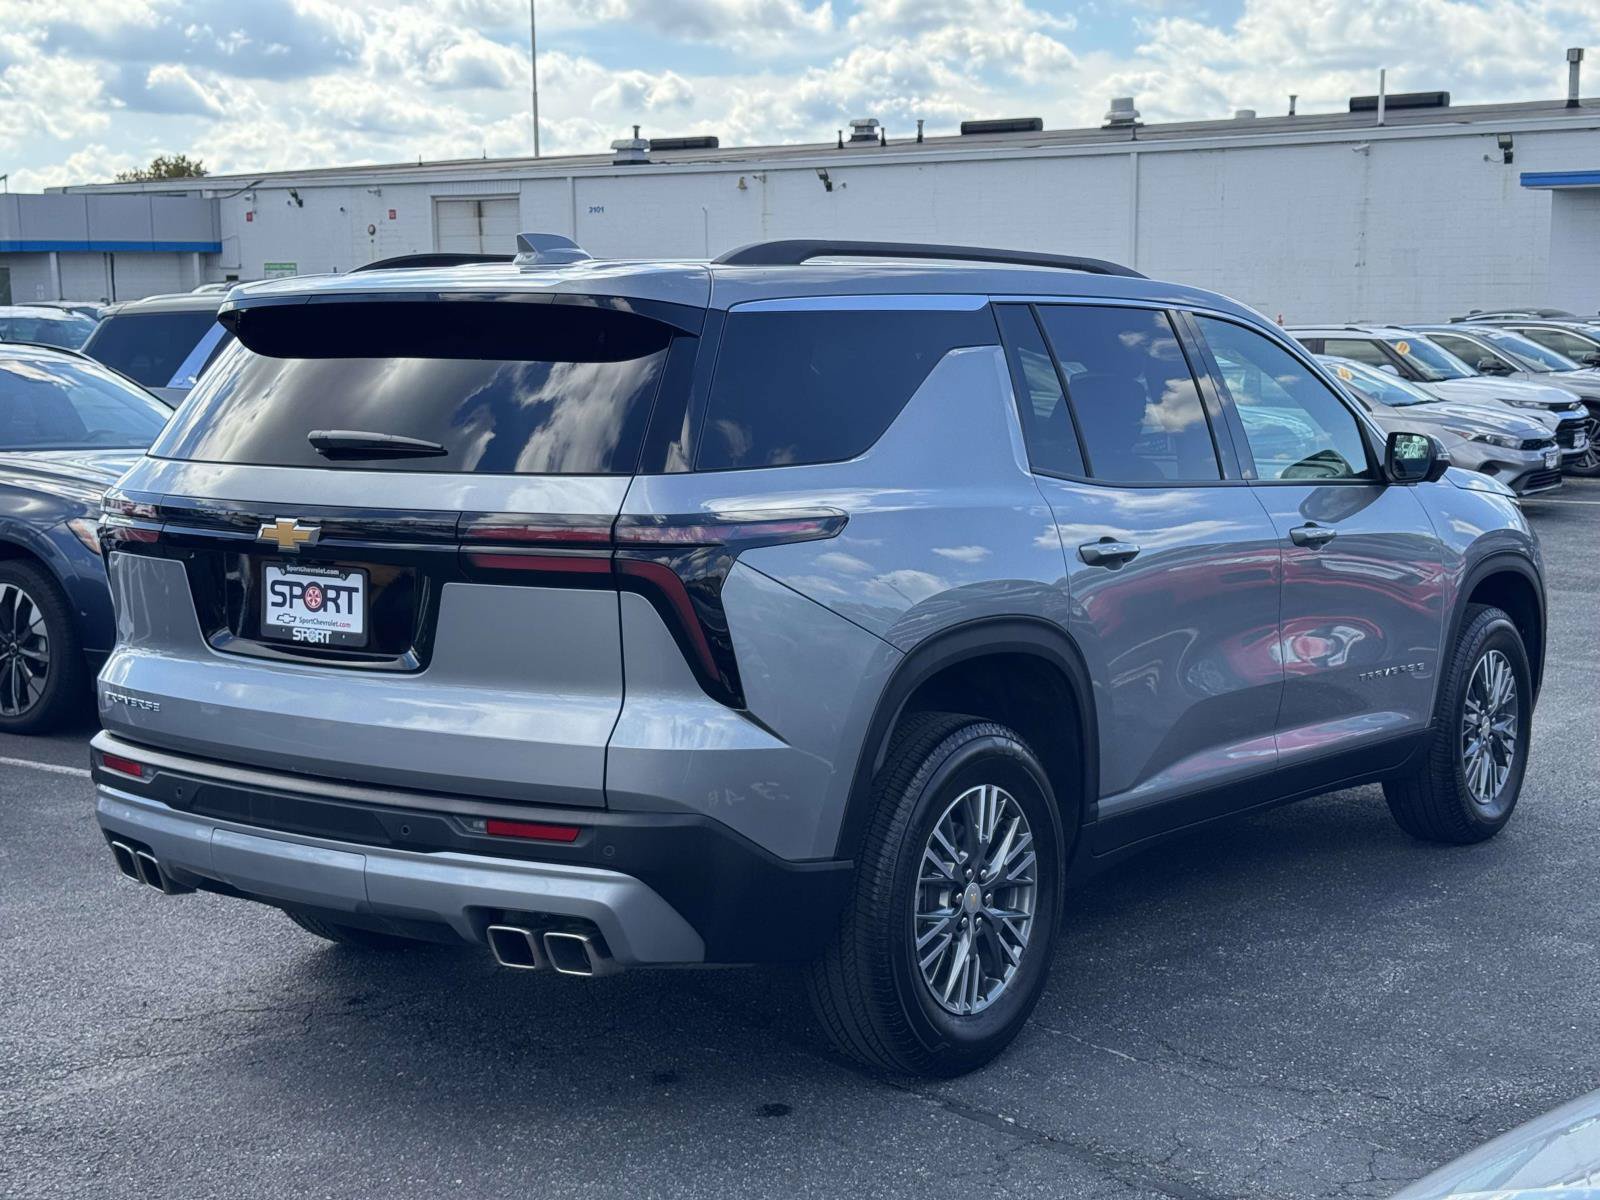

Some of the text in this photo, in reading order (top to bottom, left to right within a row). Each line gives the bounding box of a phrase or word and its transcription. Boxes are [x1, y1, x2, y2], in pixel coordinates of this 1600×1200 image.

[286, 564, 340, 575] SportChevrolet.com
[270, 580, 360, 615] SPORT
[299, 616, 351, 628] SportChevrolet.com
[292, 627, 332, 644] SPORT
